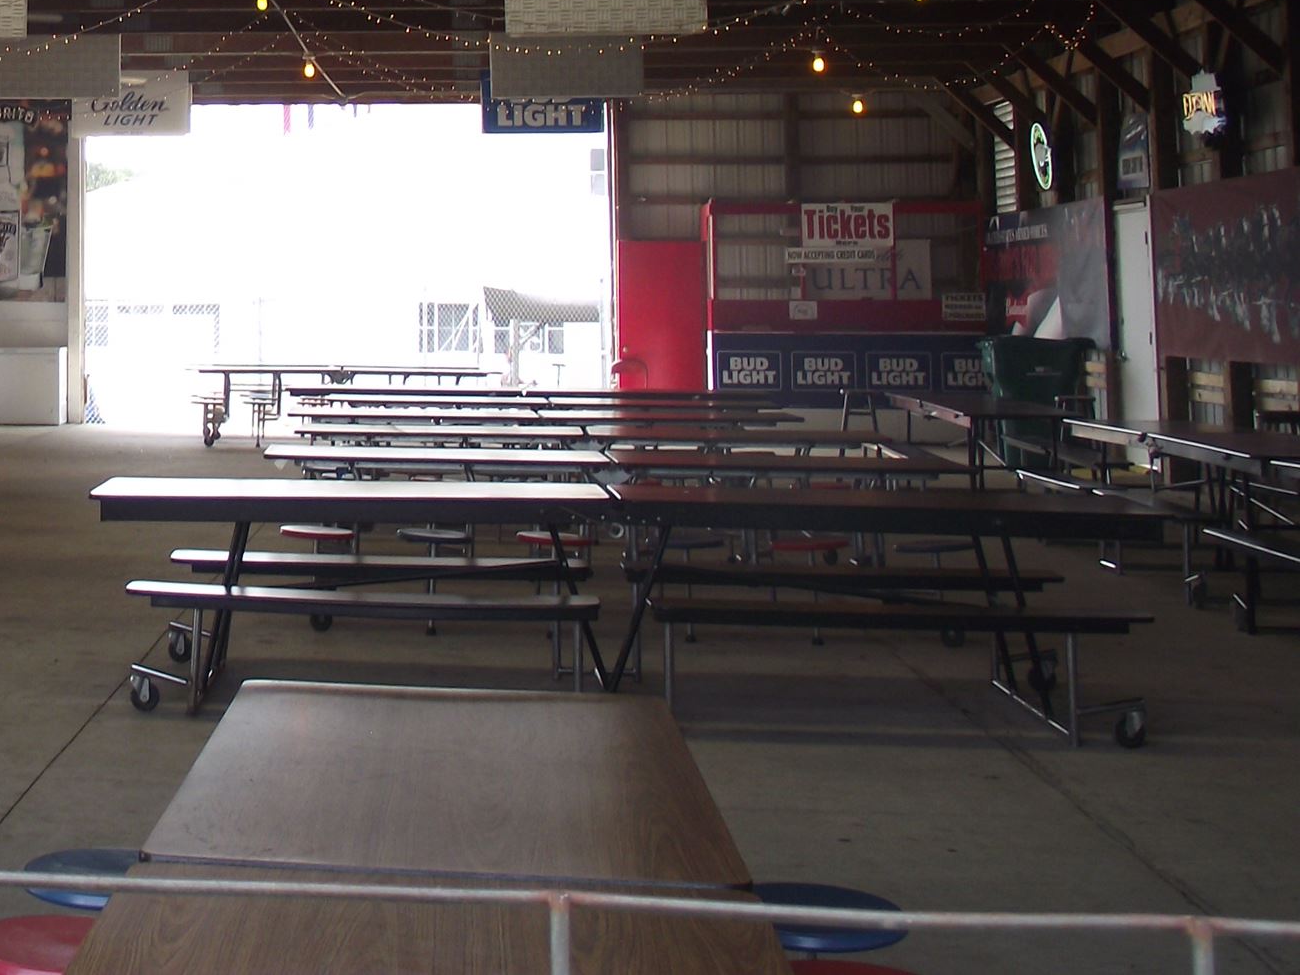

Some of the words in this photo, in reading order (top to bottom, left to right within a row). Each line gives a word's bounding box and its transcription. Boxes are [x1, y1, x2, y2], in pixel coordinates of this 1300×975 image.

[91, 91, 169, 113] Golden
[103, 113, 159, 126] LIGHT
[497, 103, 588, 127] LIGHT
[804, 208, 890, 240] Tickets
[803, 250, 835, 260] ACCEPTING
[836, 250, 856, 260] CREDIT
[811, 267, 921, 291] ULTRA
[729, 357, 769, 371] BUD
[803, 357, 844, 372] BUD
[878, 358, 919, 372] BUD
[953, 358, 984, 373] BU
[722, 370, 777, 386] LIGHT
[796, 371, 851, 386] LIGHT
[871, 371, 927, 387] LIGHT
[946, 372, 988, 387] LIGH
